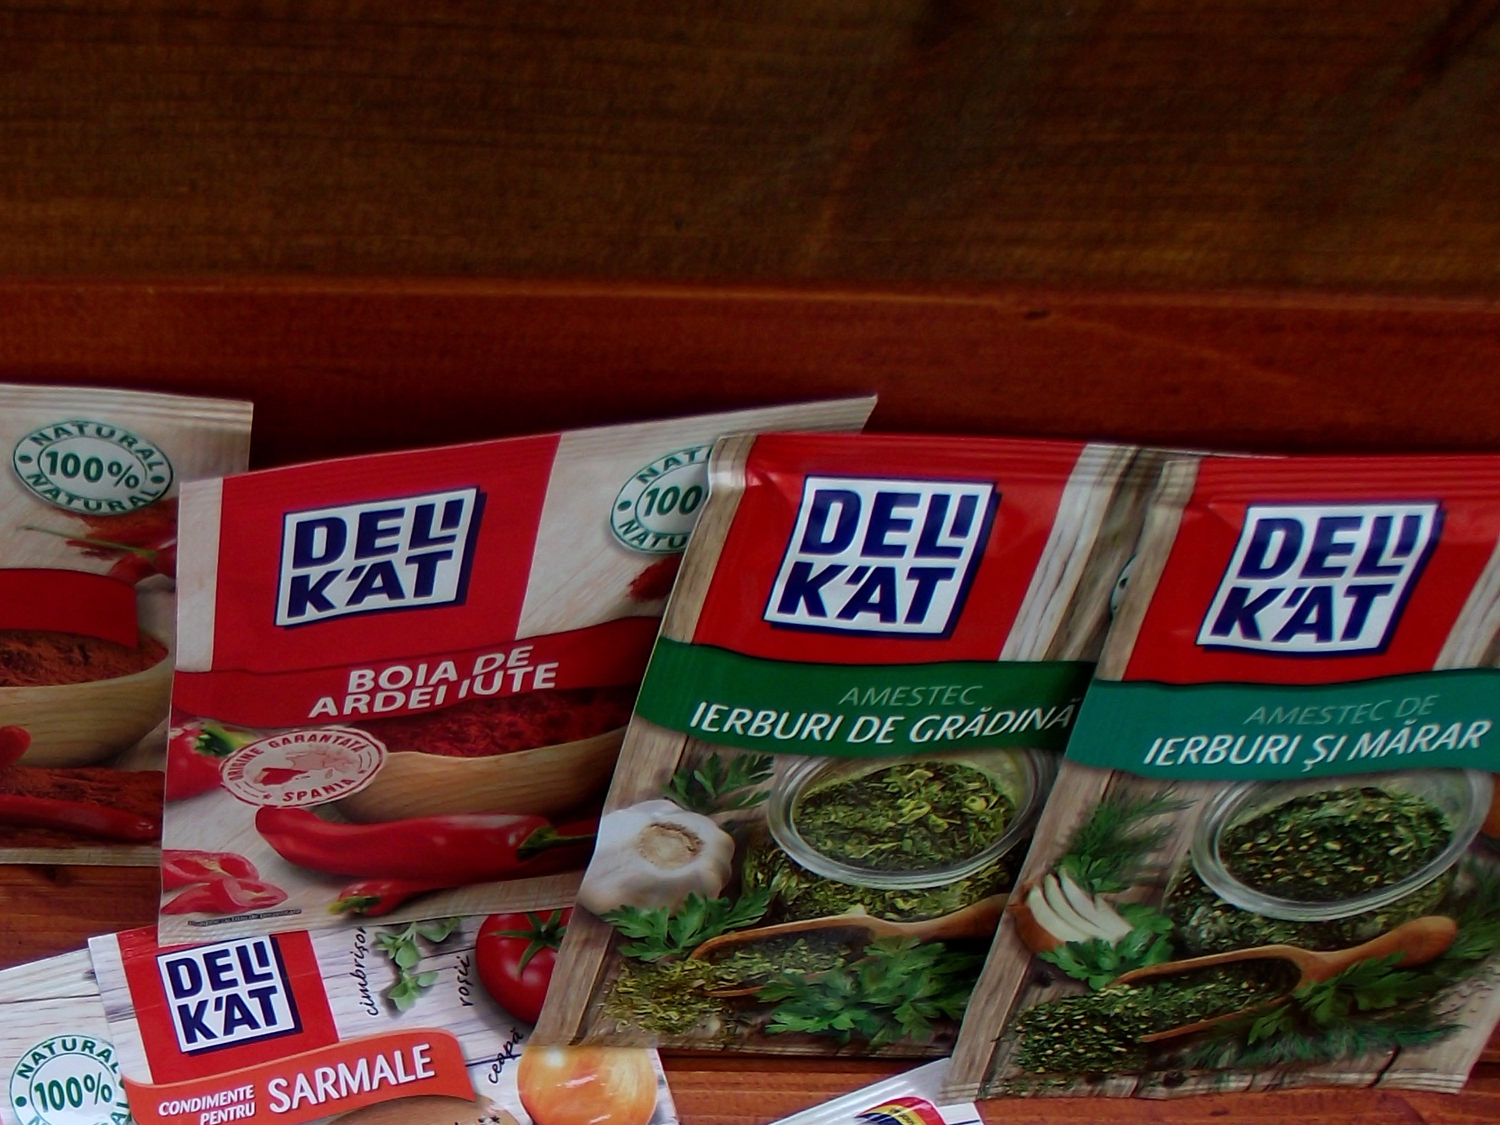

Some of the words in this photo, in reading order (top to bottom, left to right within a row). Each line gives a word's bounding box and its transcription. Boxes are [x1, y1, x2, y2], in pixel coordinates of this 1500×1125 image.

[29, 424, 164, 472] NATURAL
[45, 452, 139, 488] 100%
[27, 474, 160, 511] NATURAL
[293, 499, 465, 569] DELI
[799, 489, 981, 560] DELI
[1237, 514, 1420, 580] DELI
[308, 684, 447, 718] ARDEI
[457, 662, 560, 699] IUTE
[347, 660, 457, 694] BOIA
[472, 645, 534, 675] DE
[690, 701, 845, 742] IERBURI
[847, 715, 906, 744] DE
[909, 696, 1083, 744] GRĂDINĂ
[837, 685, 984, 707] AMESTEC
[1243, 700, 1391, 727] AMESTEC
[1395, 694, 1440, 716] DE
[1143, 732, 1304, 767] IERBURI
[1347, 718, 1492, 761] MĂRAR
[283, 778, 355, 802] SPANIA
[165, 940, 274, 1000] DELI
[17, 1038, 119, 1079] NATURAL
[159, 1085, 254, 1116] CONDIMENTE
[268, 1043, 435, 1113] SARMALE
[488, 1027, 524, 1084] ceapă
[34, 1072, 112, 1113] 100%
